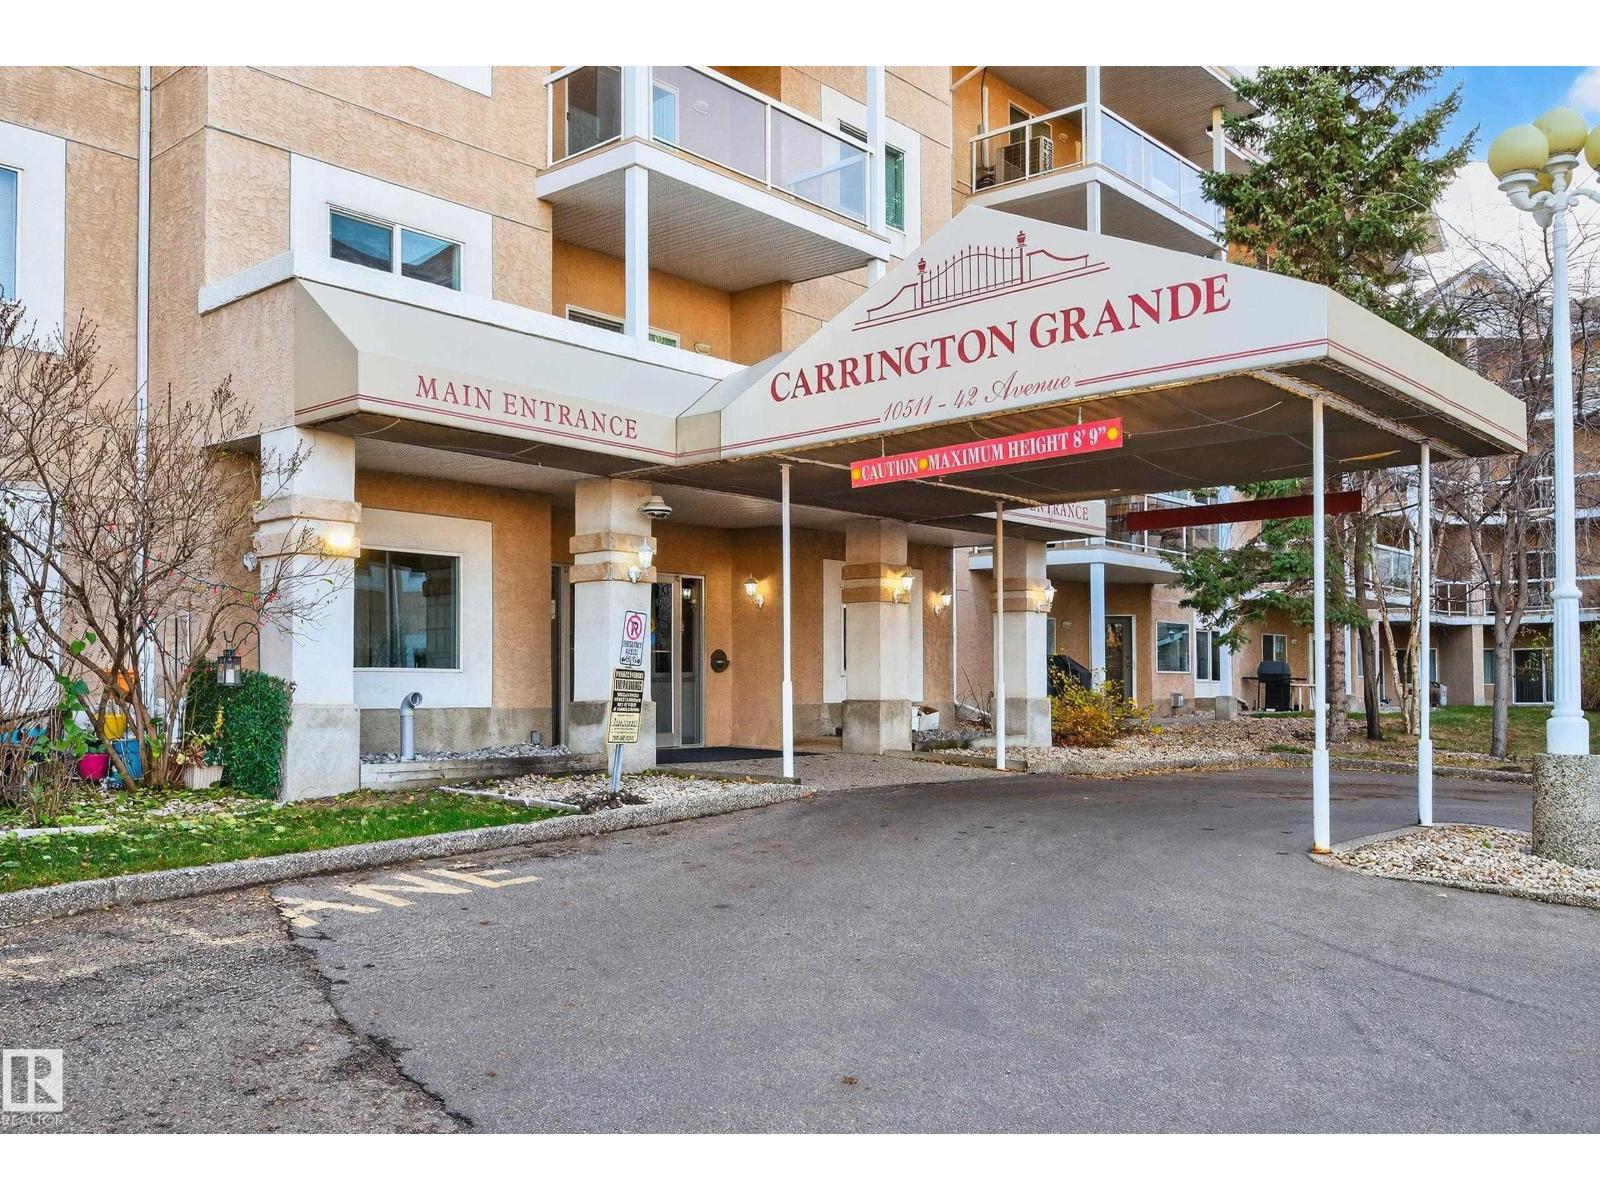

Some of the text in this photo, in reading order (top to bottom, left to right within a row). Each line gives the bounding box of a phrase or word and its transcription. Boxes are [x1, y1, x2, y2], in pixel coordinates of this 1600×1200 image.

[769, 273, 1232, 403] CARRINGTON GRANDE
[415, 374, 638, 440] MAIN ENTRANCE
[883, 394, 934, 422] 10511
[953, 386, 979, 409] 42
[984, 369, 1072, 403] Avenue
[861, 457, 919, 481] CAUTION
[928, 442, 1004, 471] MAXIMUM
[1007, 432, 1069, 459] HEIGHT
